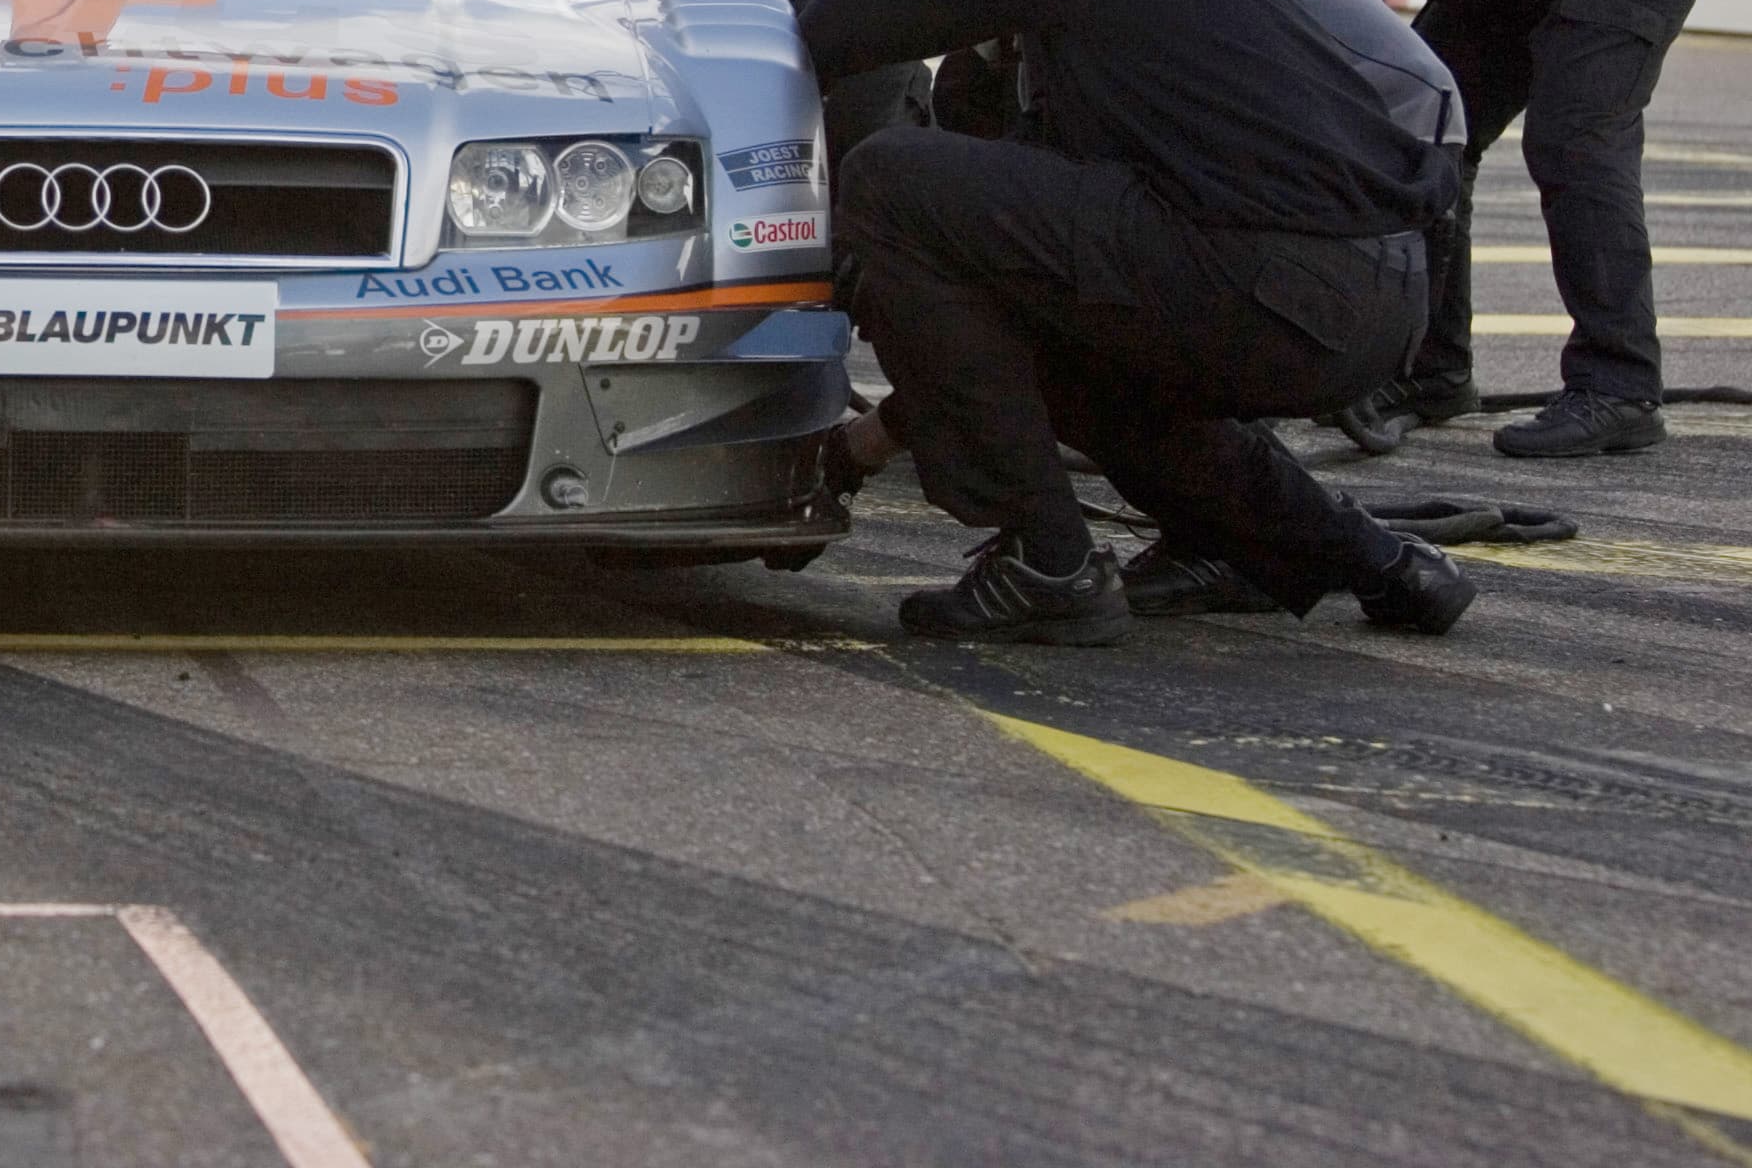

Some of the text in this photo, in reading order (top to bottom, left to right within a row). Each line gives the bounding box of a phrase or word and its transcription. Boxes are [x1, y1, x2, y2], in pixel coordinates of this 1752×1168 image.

[749, 145, 800, 164] JOEST
[750, 163, 813, 182] RACING
[753, 217, 817, 244] Castrol
[356, 258, 625, 299] Audi Bank
[460, 315, 701, 366] DUNLOP
